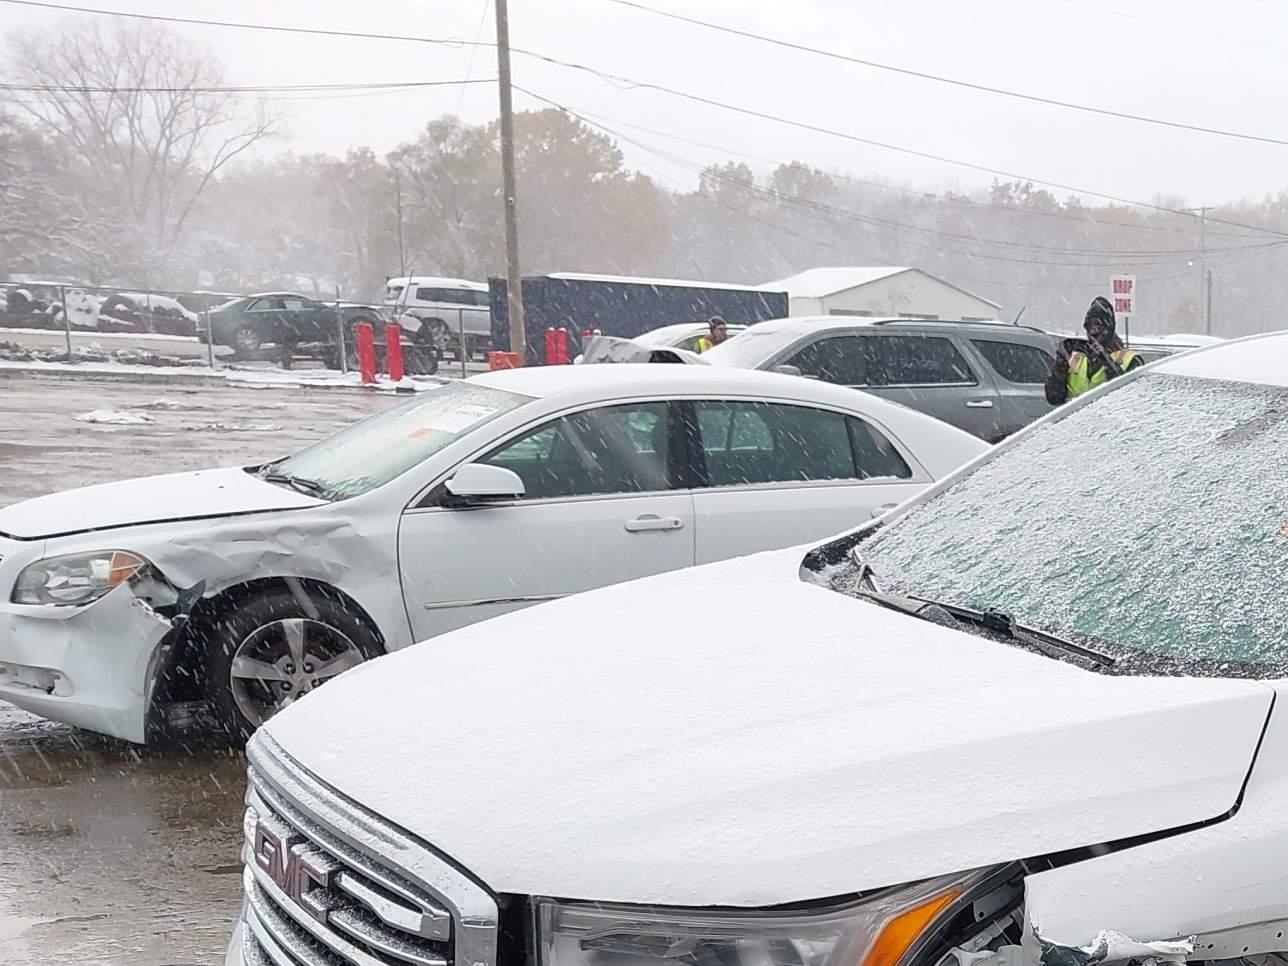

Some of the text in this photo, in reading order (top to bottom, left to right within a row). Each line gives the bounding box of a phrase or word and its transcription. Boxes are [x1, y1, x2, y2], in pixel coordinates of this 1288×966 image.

[1113, 279, 1132, 294] DROP
[1114, 298, 1131, 313] ZONE
[255, 819, 329, 924] GMC
